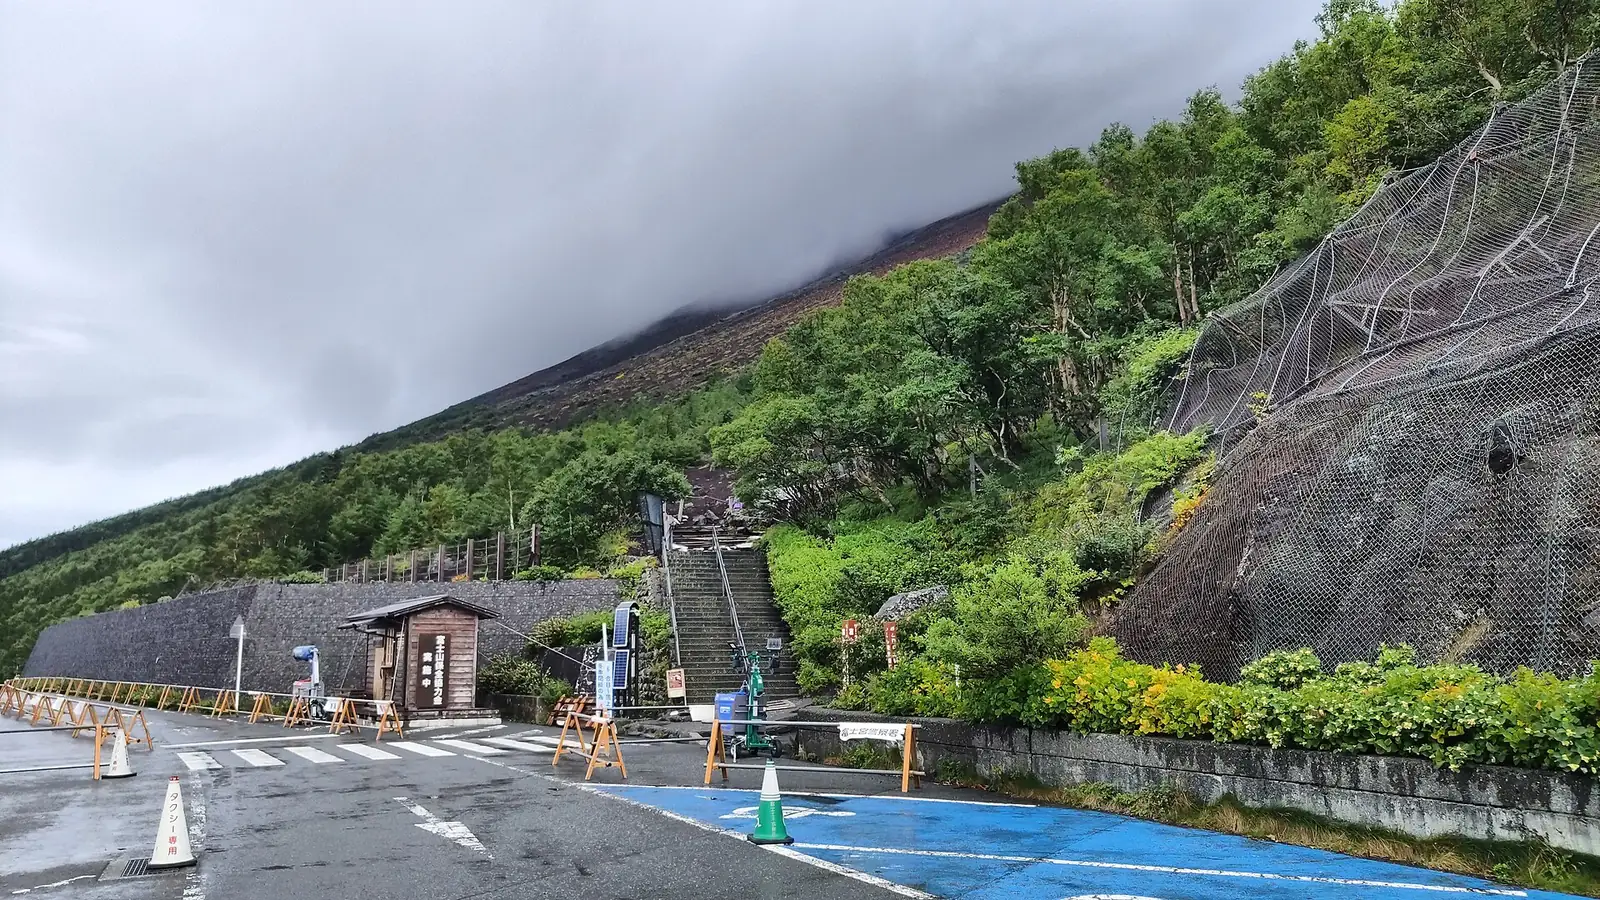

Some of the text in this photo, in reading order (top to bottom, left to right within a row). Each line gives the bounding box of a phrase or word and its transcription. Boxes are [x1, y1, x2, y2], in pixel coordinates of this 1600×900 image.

[422, 652, 433, 688] 実施中
[168, 792, 179, 856] タクシー専用
